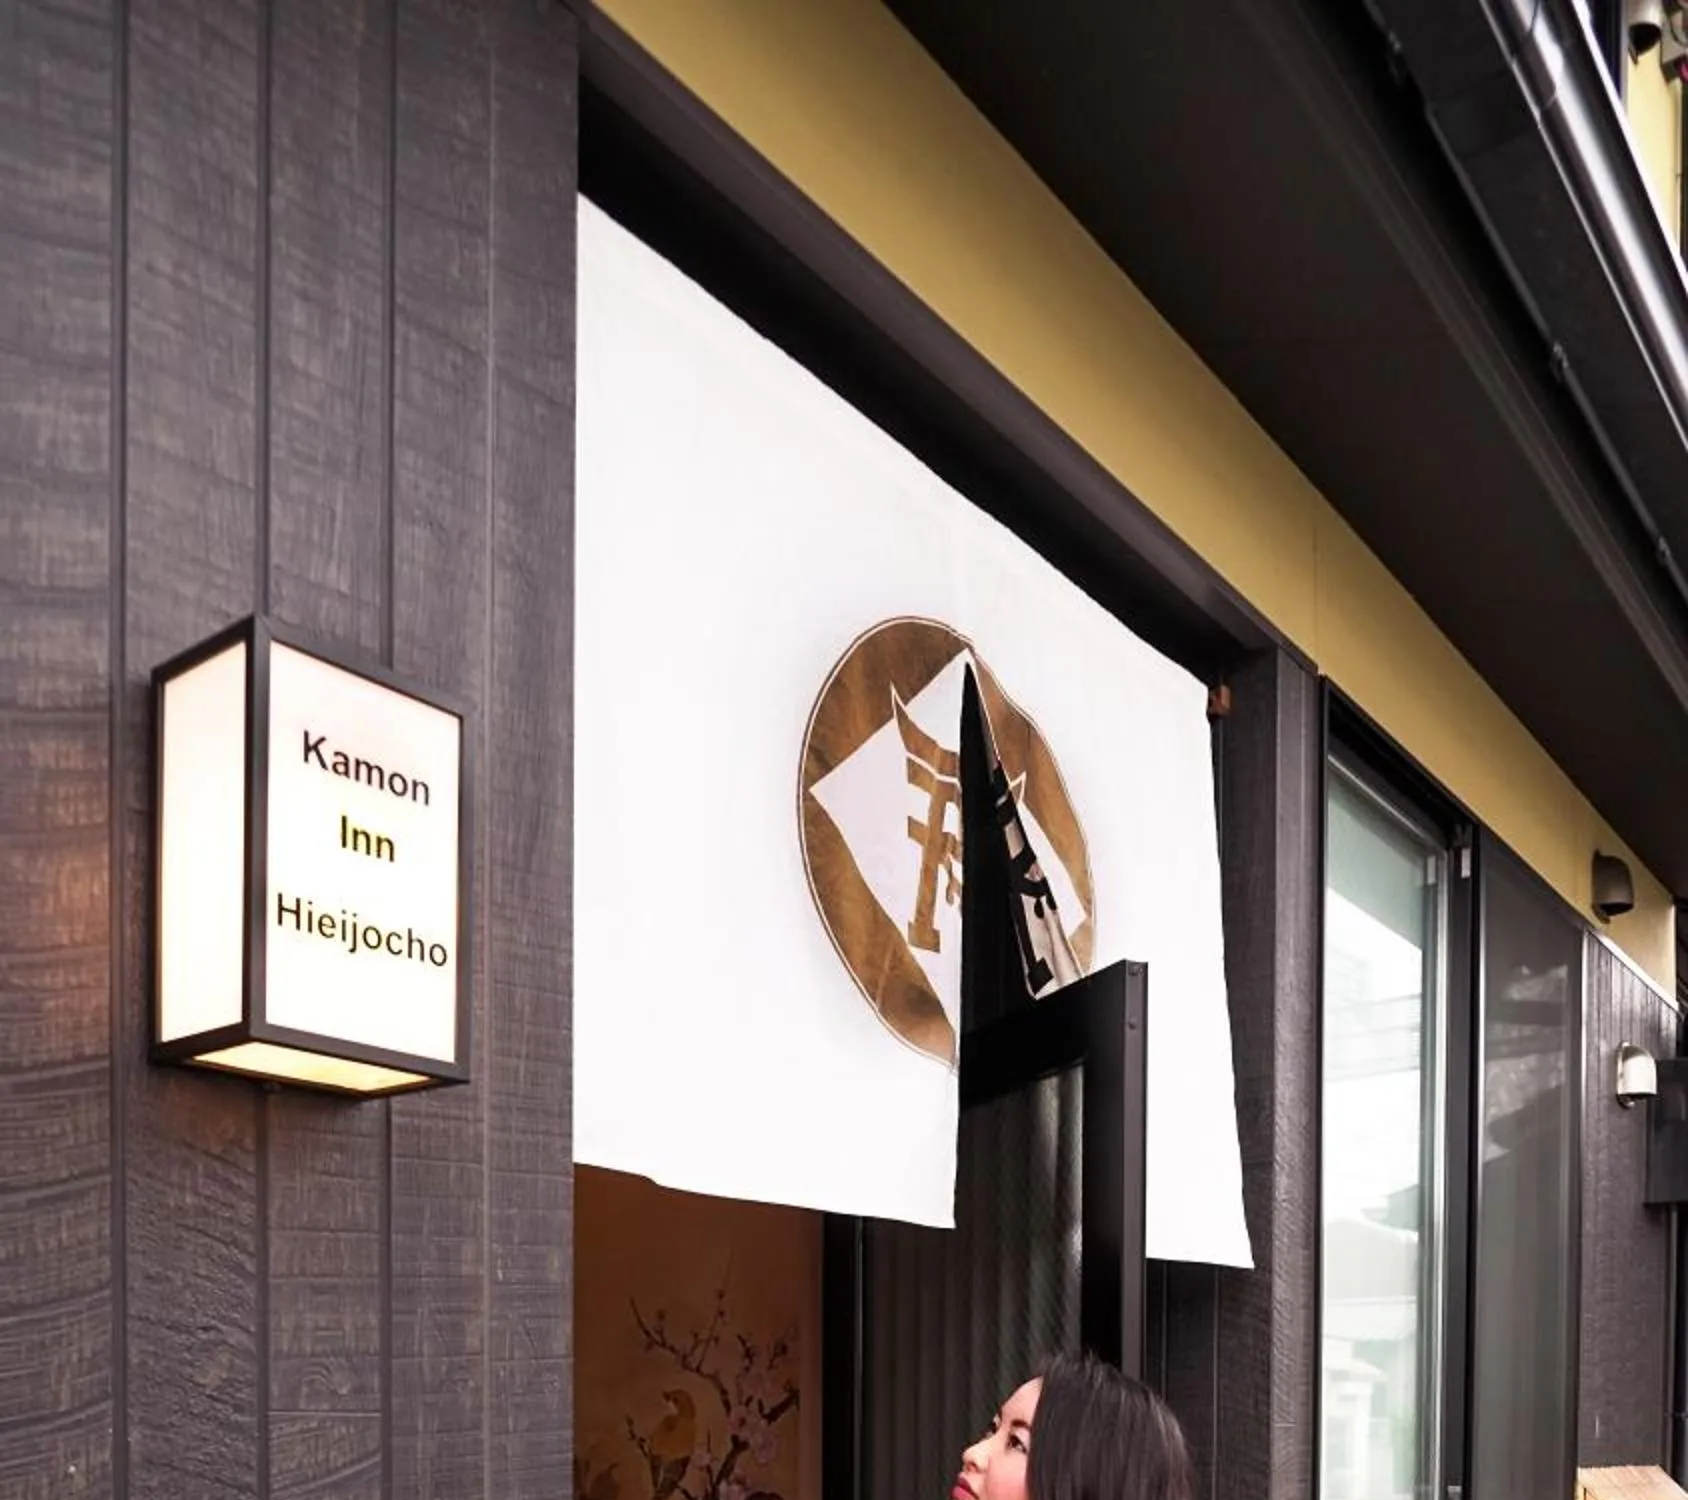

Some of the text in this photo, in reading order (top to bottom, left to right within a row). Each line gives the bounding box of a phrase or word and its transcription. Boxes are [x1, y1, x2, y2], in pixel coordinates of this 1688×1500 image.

[303, 729, 430, 806] Kamon
[340, 815, 395, 862] Inn
[277, 892, 448, 967] Hieijocho
